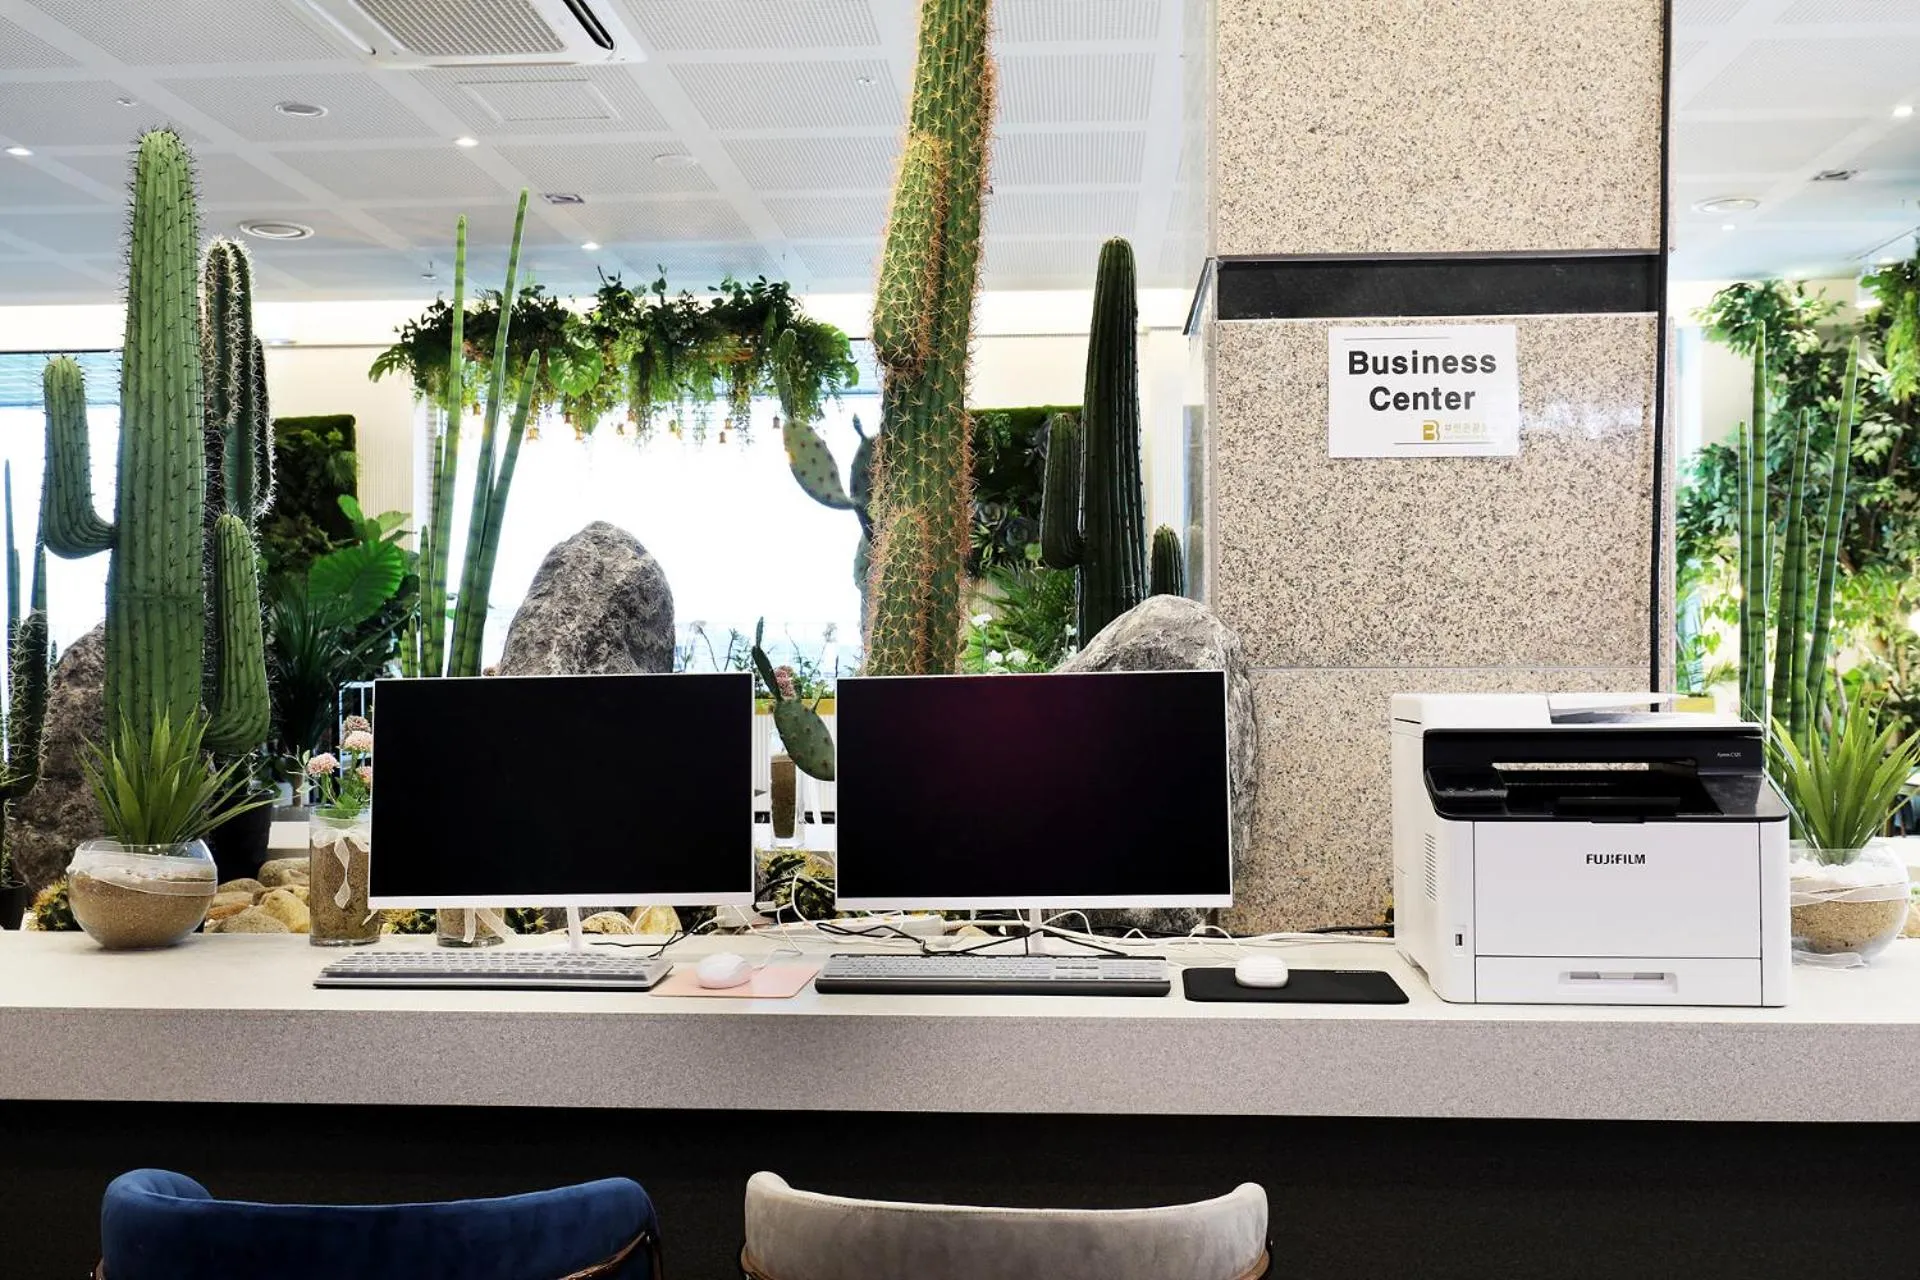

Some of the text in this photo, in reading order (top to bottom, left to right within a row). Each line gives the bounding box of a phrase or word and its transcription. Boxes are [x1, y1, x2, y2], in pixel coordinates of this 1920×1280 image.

[1348, 350, 1497, 375] Business
[1369, 386, 1476, 411] Center
[1586, 854, 1646, 864] FUJIFILM
